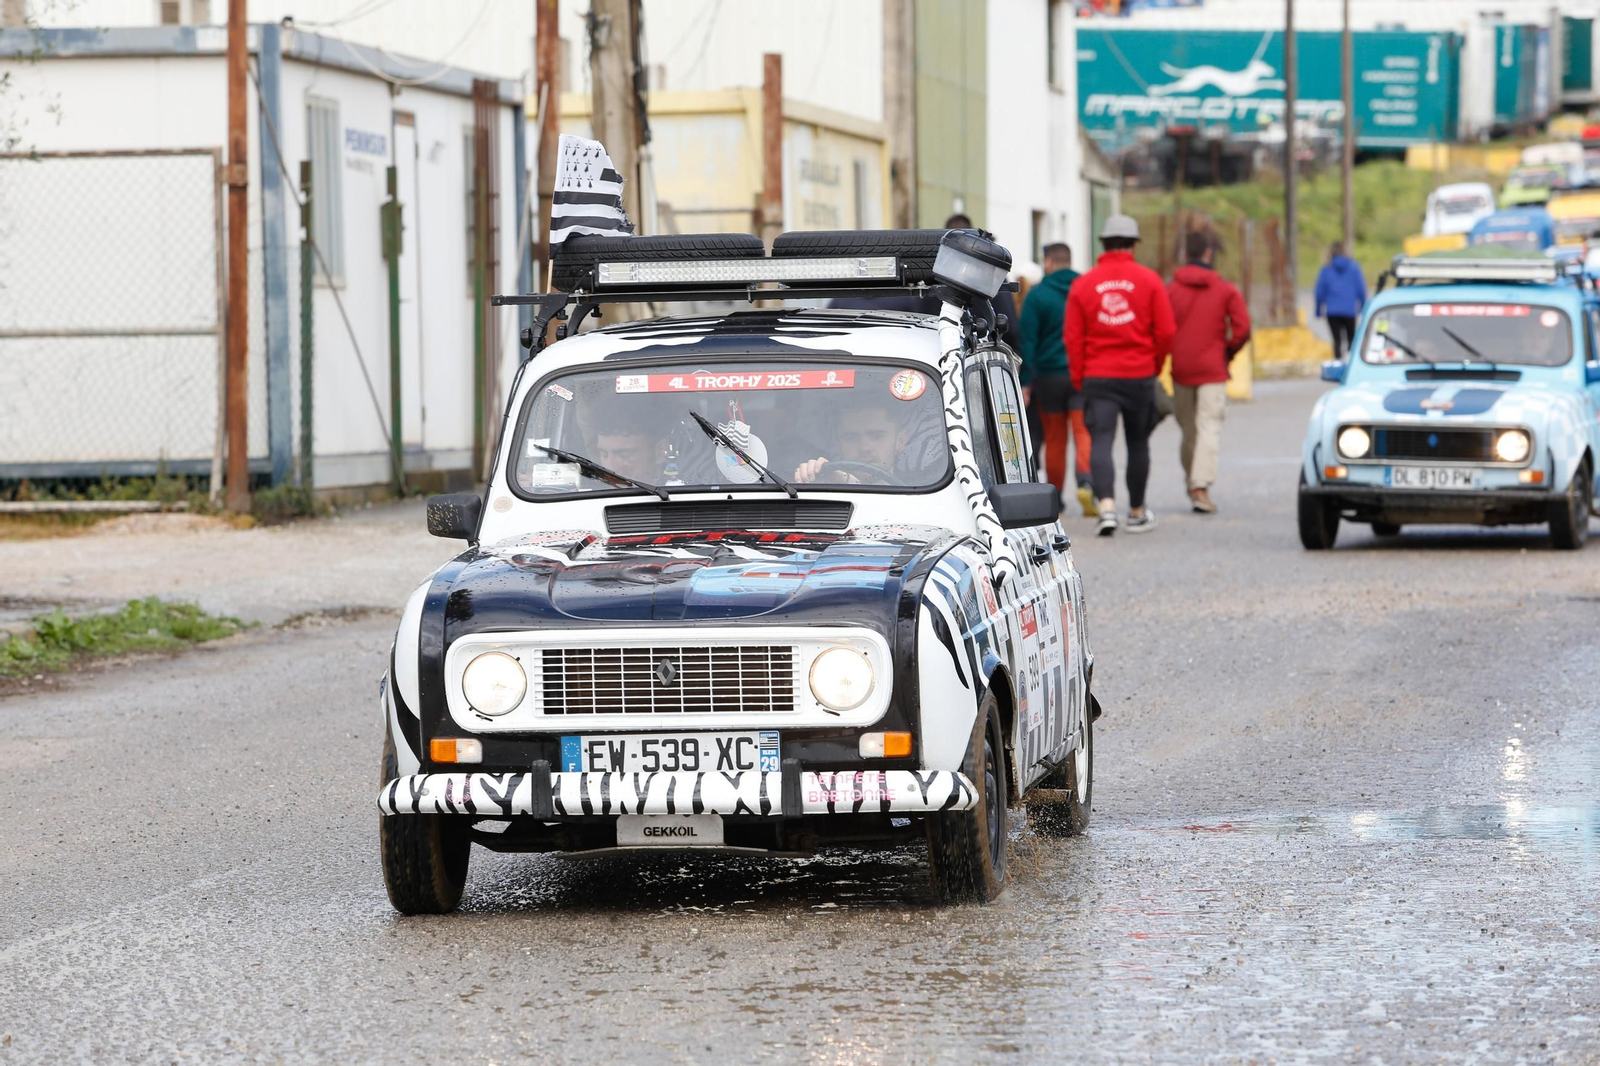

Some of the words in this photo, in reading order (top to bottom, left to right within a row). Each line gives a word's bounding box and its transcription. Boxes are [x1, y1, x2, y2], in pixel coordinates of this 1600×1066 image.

[669, 377, 689, 389] 4L
[695, 374, 763, 388] TROPHY
[767, 374, 801, 387] 2025
[1420, 469, 1448, 484] 810
[569, 762, 576, 772] F
[760, 756, 779, 771] 29
[808, 789, 896, 803] BRETONNE
[643, 826, 698, 837] GEKKOIL
